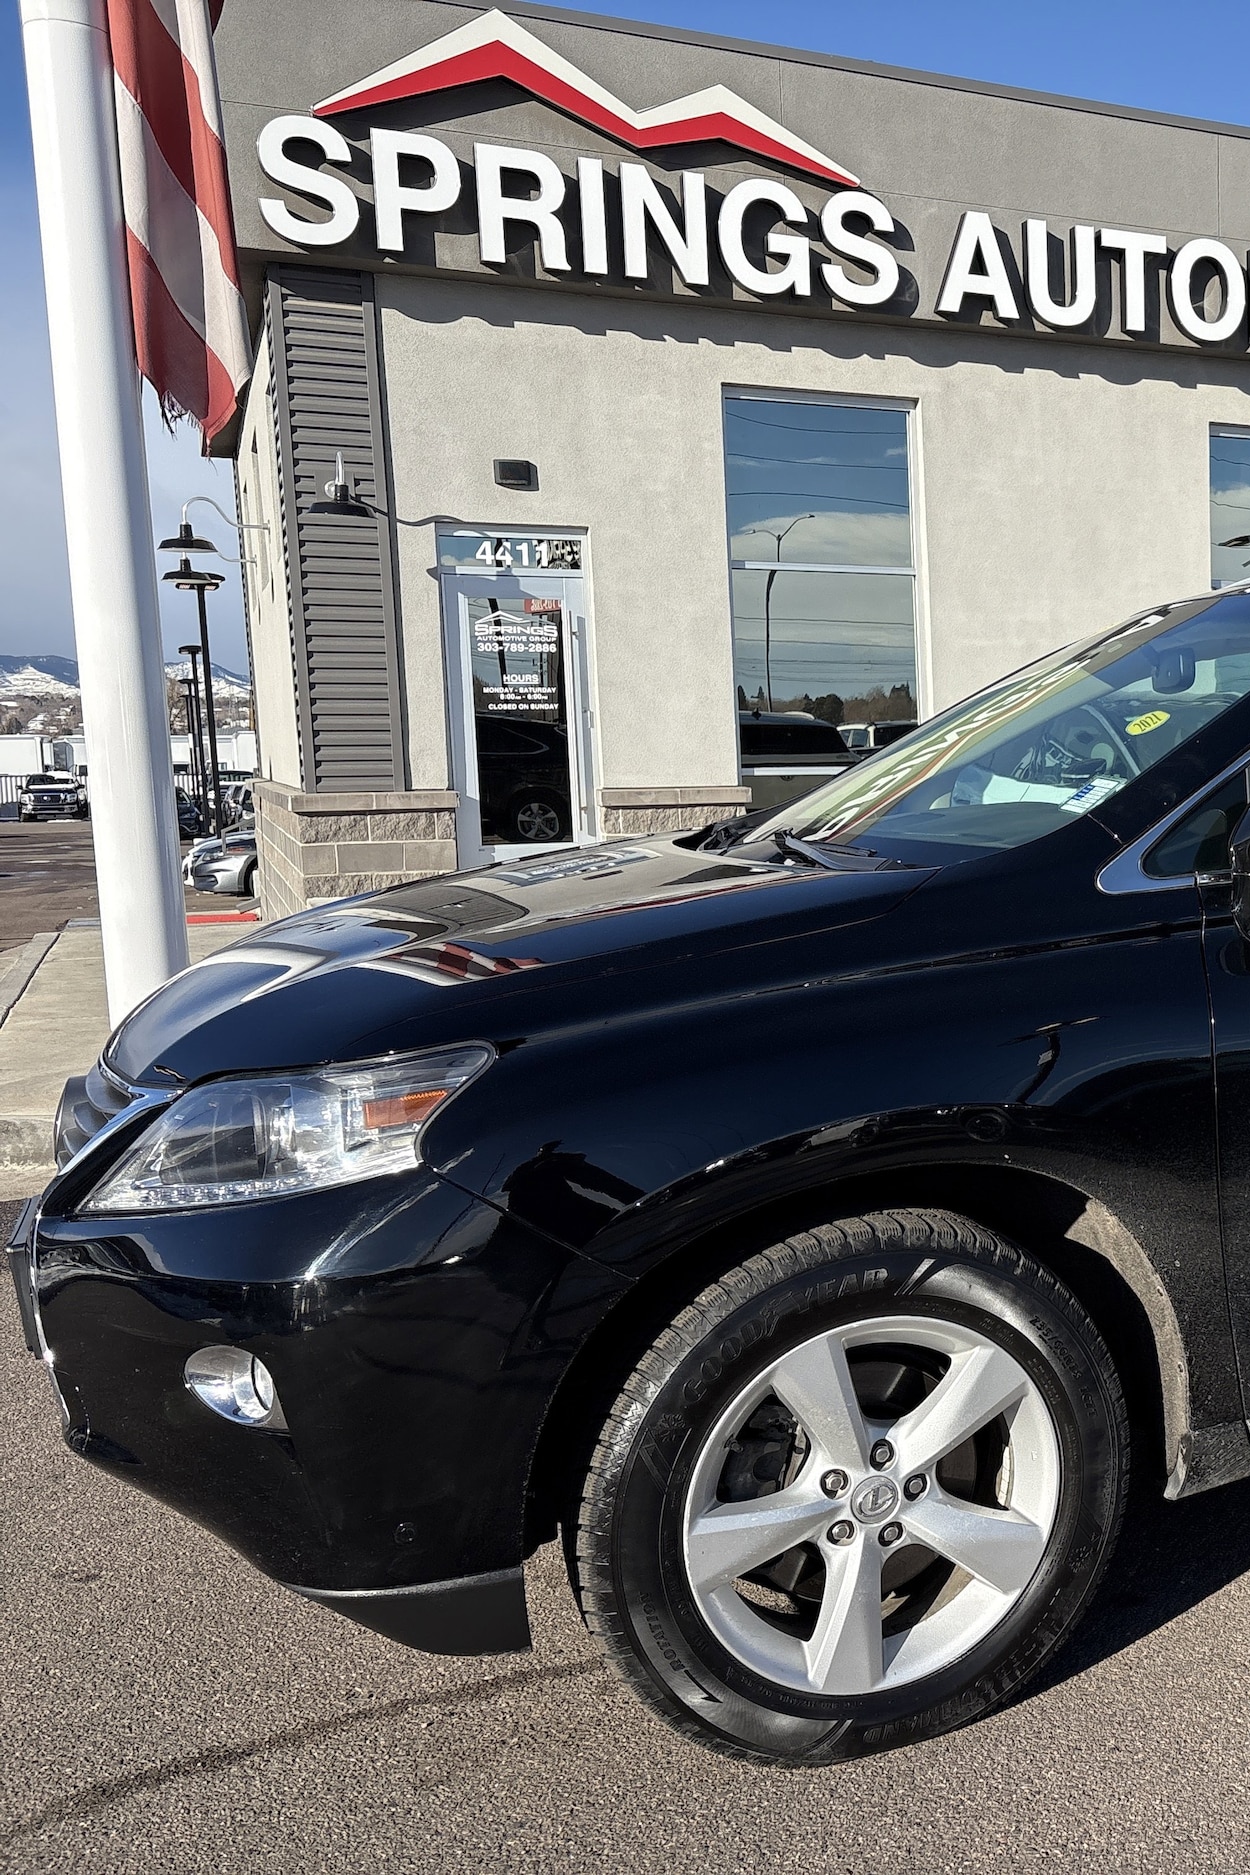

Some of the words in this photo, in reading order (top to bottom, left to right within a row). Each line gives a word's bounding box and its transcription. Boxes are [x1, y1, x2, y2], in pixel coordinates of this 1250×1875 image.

[257, 114, 900, 305] SPRINGS
[475, 540, 549, 567] 4411
[474, 624, 558, 637] SPRINGS
[477, 642, 557, 653] 303-789-2886
[502, 674, 539, 682] HOURS
[1132, 713, 1163, 732] 2021
